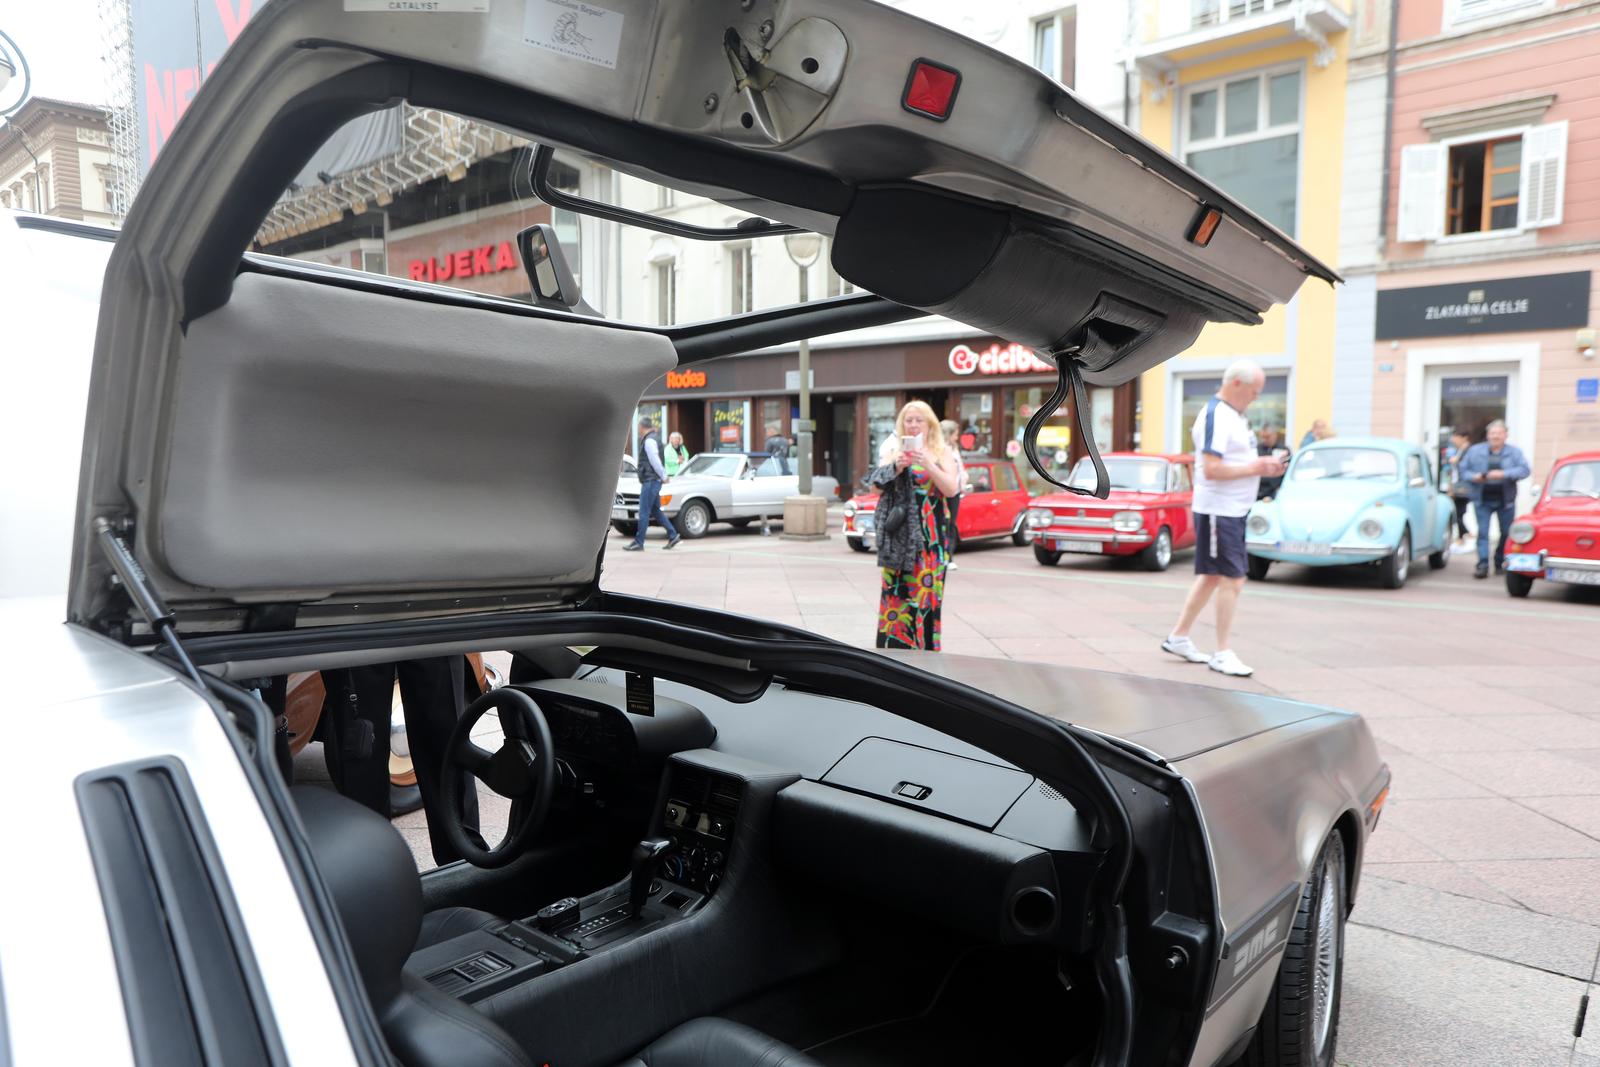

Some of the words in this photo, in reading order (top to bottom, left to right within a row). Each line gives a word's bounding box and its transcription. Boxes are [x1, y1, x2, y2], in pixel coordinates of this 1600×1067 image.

[388, 2, 440, 10] CATALYST
[407, 239, 517, 283] RIJEKA
[1425, 302, 1489, 320] ZLATARNA
[1490, 298, 1529, 315] CELJE
[666, 369, 707, 388] Rodea
